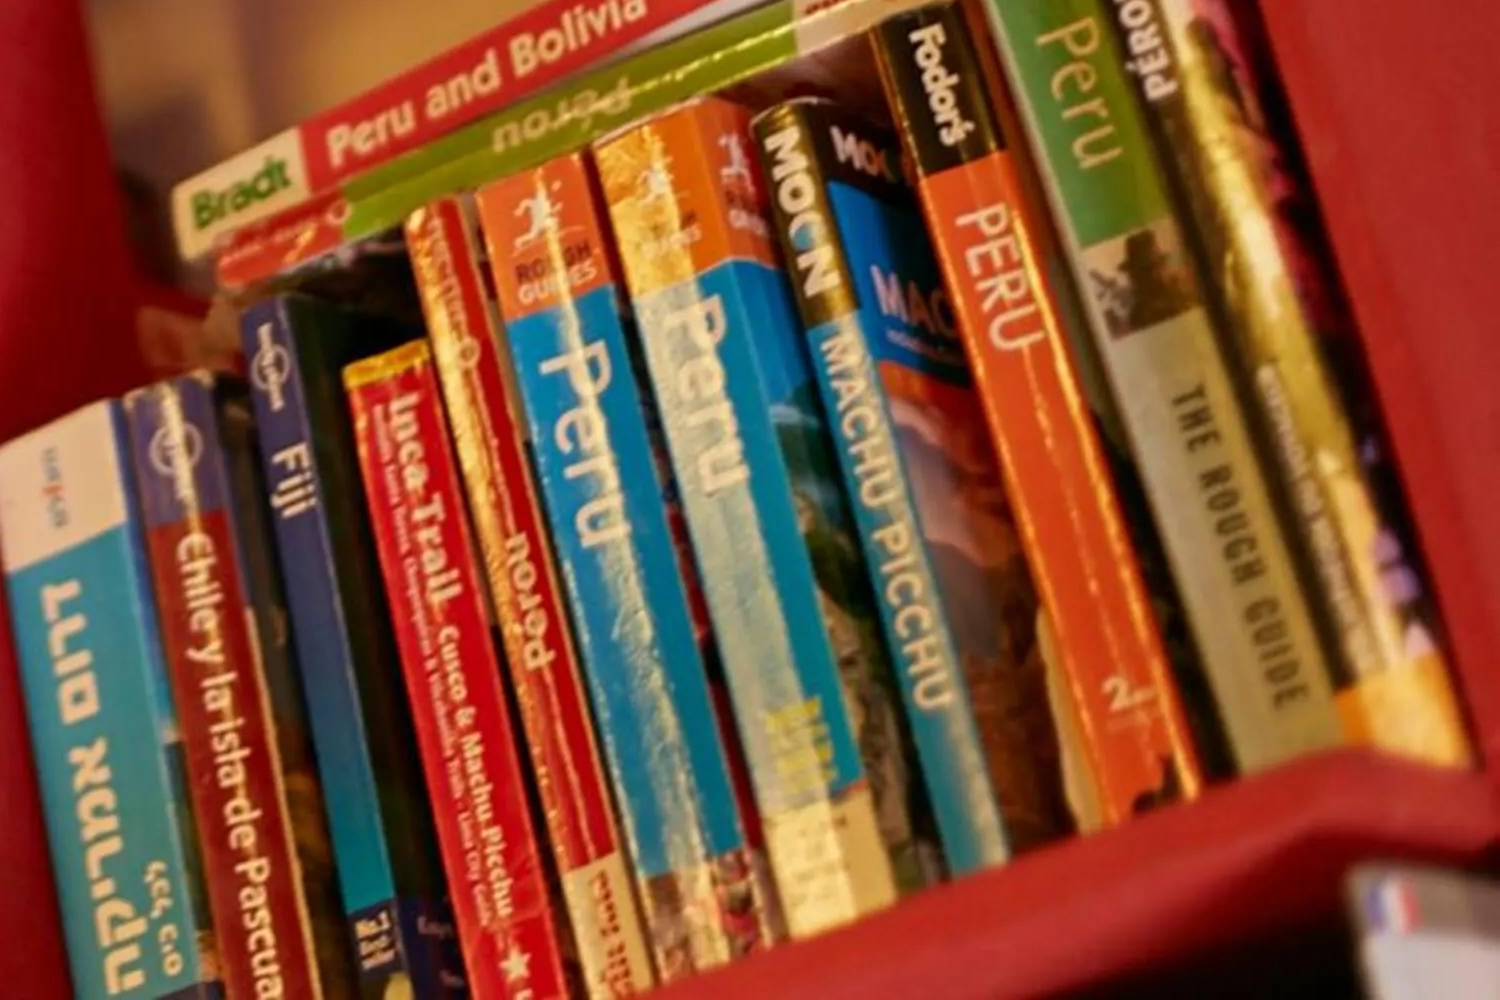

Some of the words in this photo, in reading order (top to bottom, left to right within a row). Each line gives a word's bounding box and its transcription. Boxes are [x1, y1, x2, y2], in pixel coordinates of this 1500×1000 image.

[325, 96, 416, 170] Peru
[425, 48, 501, 121] and
[1036, 16, 1124, 169] Peru
[190, 154, 292, 231] Bradt
[764, 126, 841, 298] MOON
[517, 260, 598, 305] GUES
[955, 202, 1046, 351] PERU
[539, 339, 631, 547] Peru
[664, 294, 749, 497] Peru
[270, 442, 317, 519] Fiji
[820, 330, 896, 509] MACHU
[871, 519, 954, 710] PICCHU
[1171, 383, 1222, 453] THE
[1198, 463, 1269, 587] ROUGH
[1243, 596, 1309, 711] GUIDE
[41, 578, 100, 726] דרום
[177, 530, 226, 631] Chile
[200, 671, 238, 713] la
[389, 392, 429, 493] Inca
[412, 491, 464, 603] Trail
[438, 625, 467, 702] Cusco
[461, 731, 494, 822] Machu
[481, 825, 513, 919] Picchu
[211, 719, 252, 788] isla
[224, 796, 264, 851] de
[68, 736, 149, 997] אמריקה
